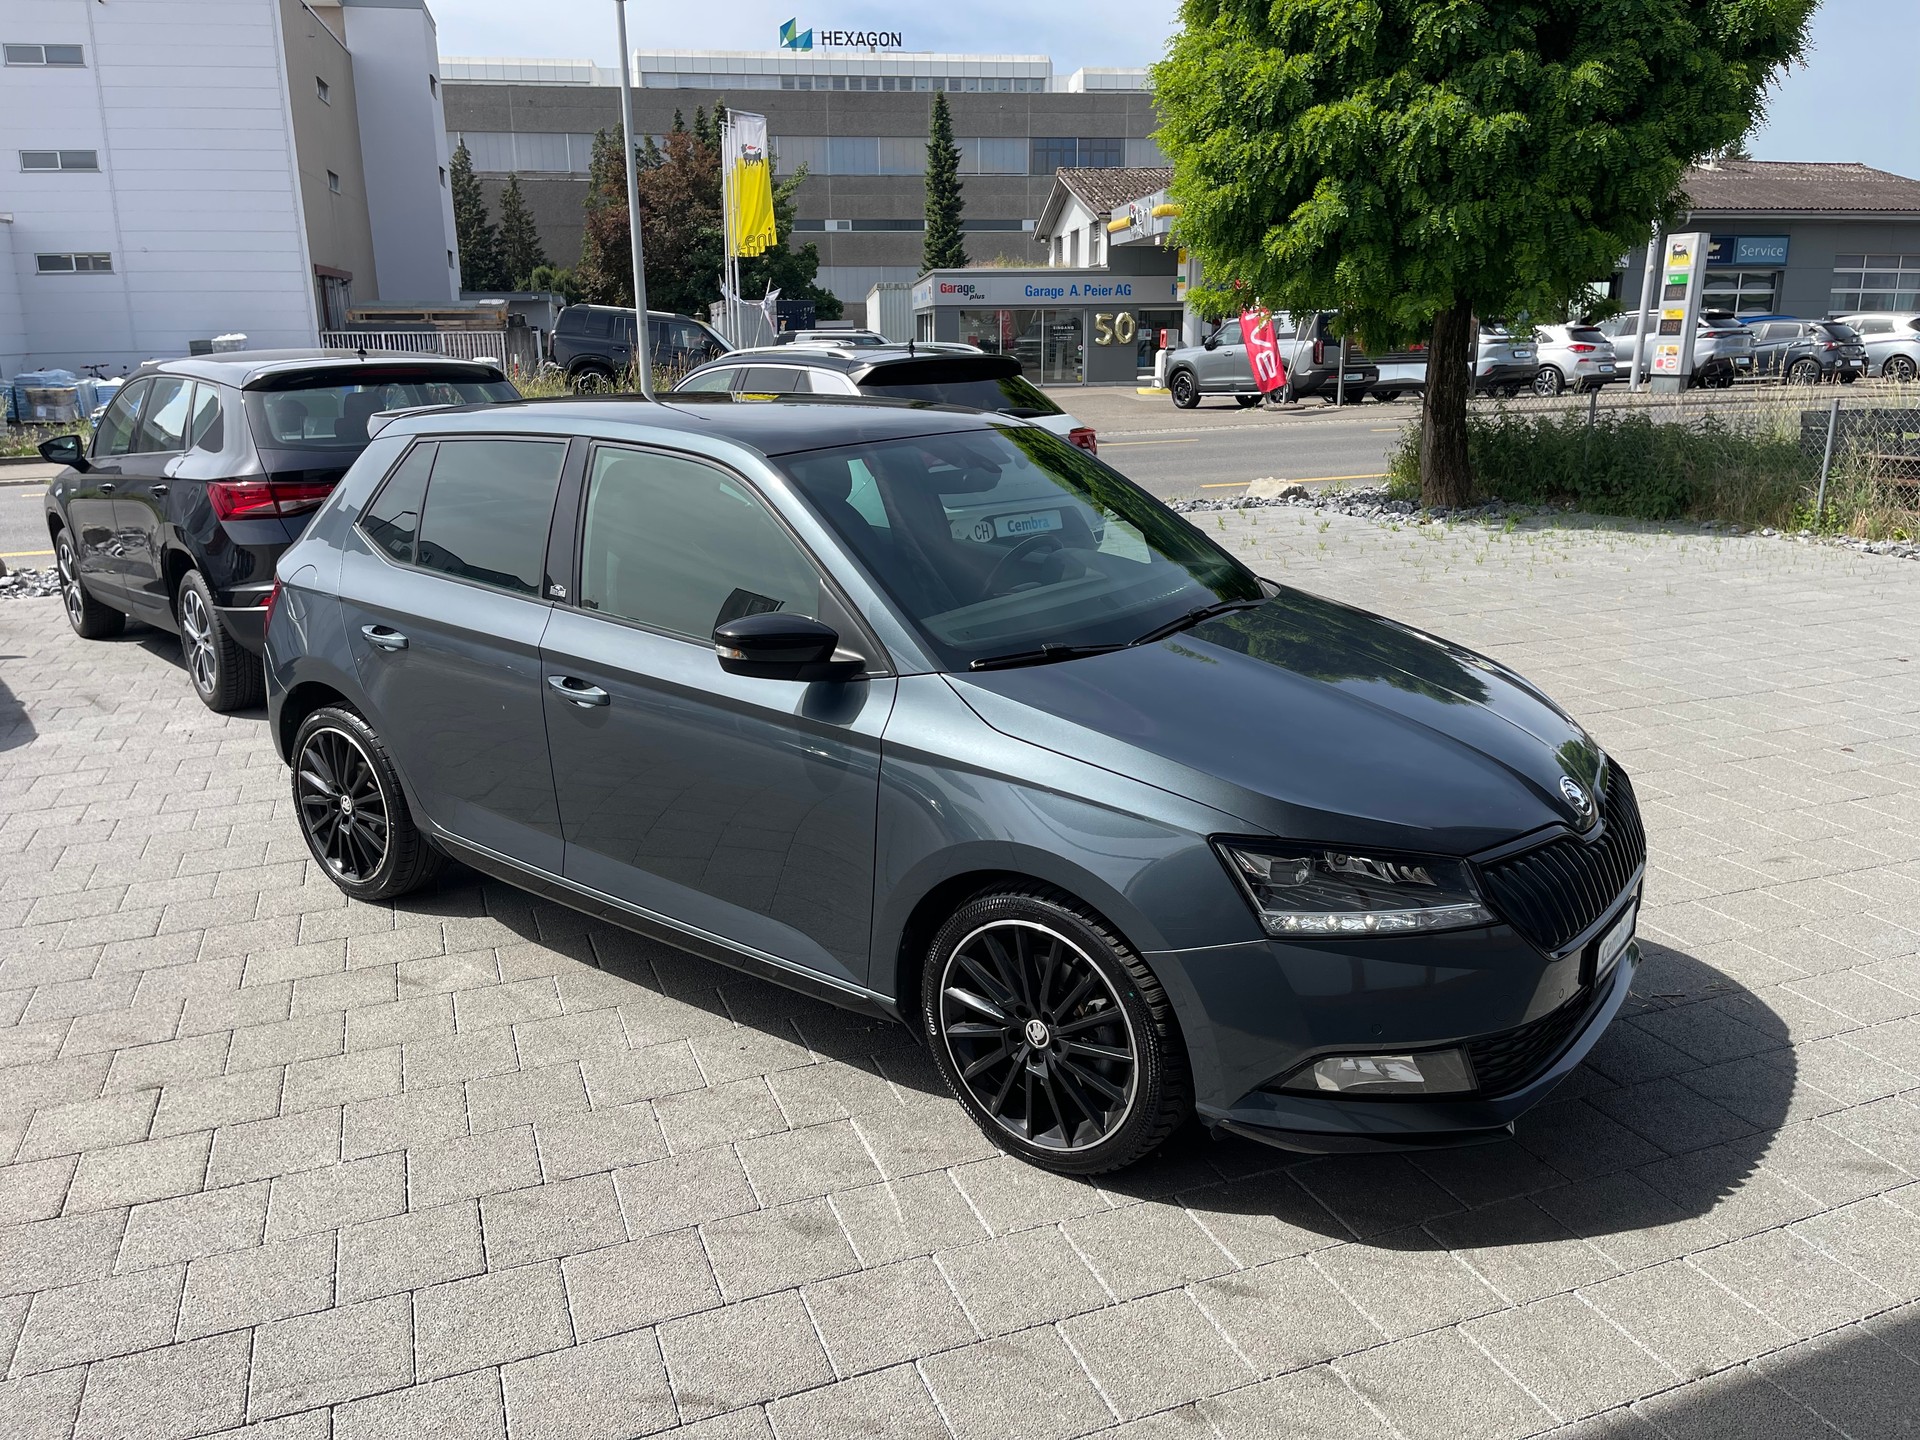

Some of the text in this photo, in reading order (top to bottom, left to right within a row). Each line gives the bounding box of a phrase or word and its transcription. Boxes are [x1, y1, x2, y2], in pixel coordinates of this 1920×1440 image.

[821, 31, 902, 47] HEXAGON
[1740, 245, 1784, 257] Service
[940, 283, 976, 296] Garage
[969, 293, 985, 301] plus
[1025, 284, 1132, 299] Garage A. Peier AG
[1095, 311, 1136, 345] 50
[974, 523, 990, 540] CH
[1007, 516, 1050, 533] Cembra
